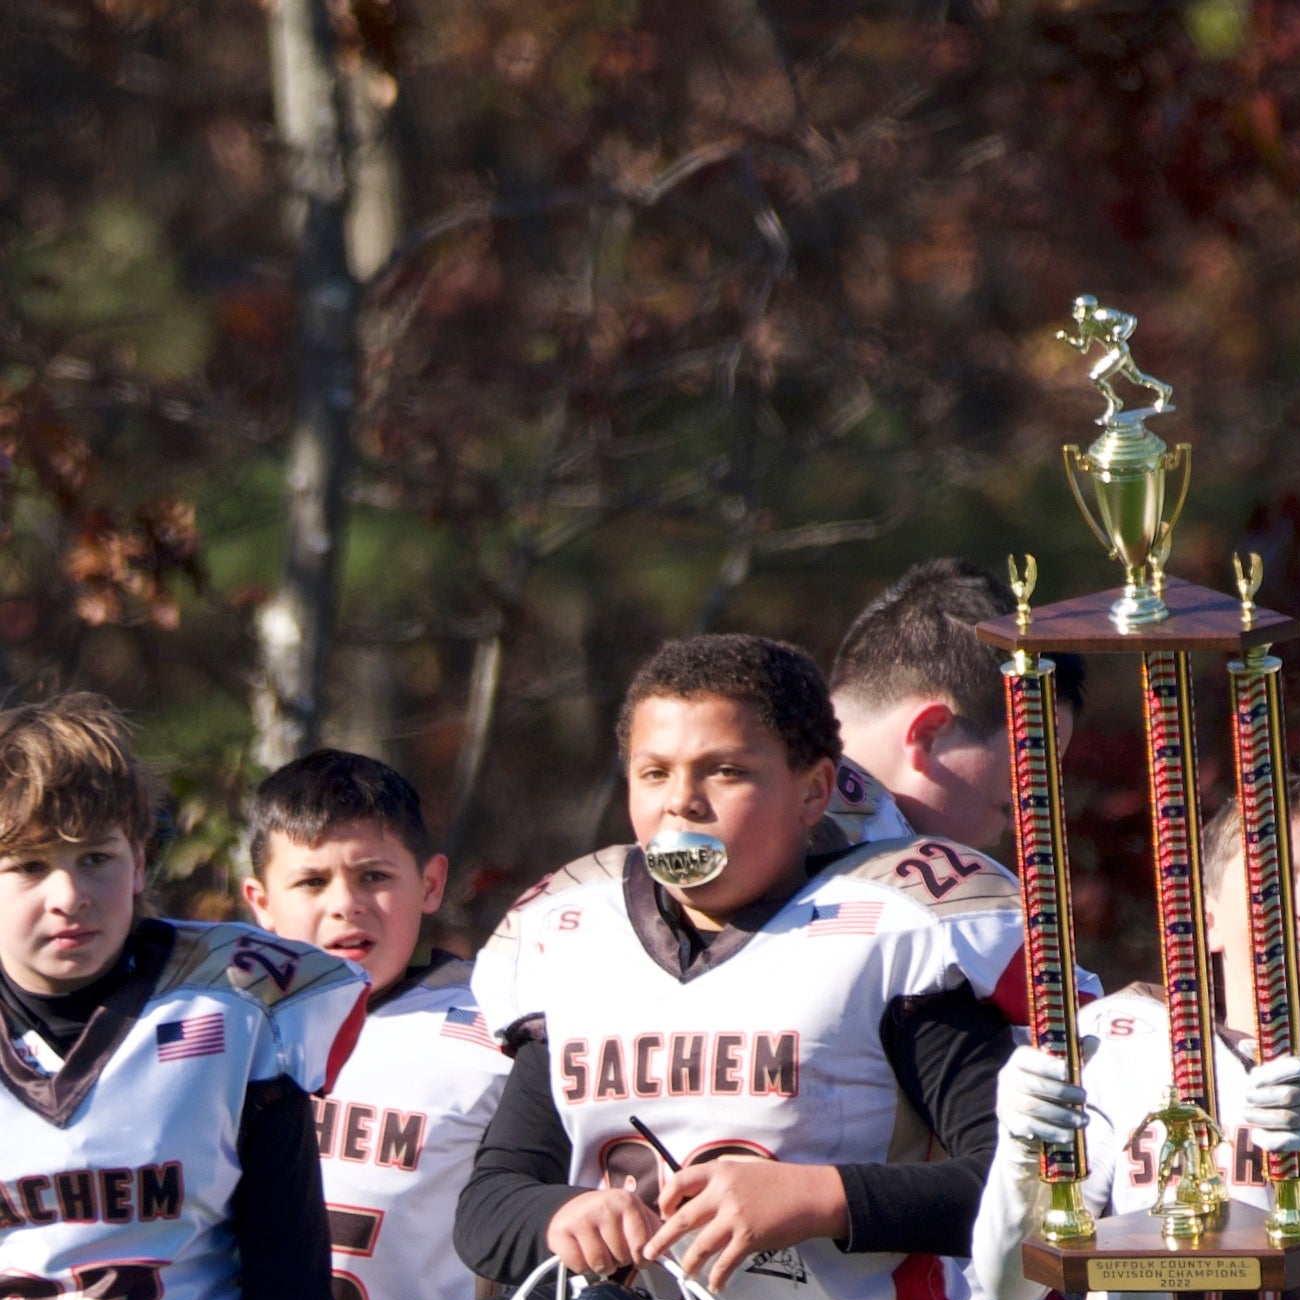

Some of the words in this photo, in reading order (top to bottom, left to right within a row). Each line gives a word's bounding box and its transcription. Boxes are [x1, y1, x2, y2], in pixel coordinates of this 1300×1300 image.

[895, 841, 984, 902] 22
[560, 1031, 800, 1105] SACHEM
[311, 1097, 427, 1172] HEM
[0, 1160, 185, 1230] ACHEM
[1096, 1261, 1155, 1270] SUFFOLK
[1160, 1260, 1211, 1269] COUNTY
[1103, 1270, 1163, 1279] DIVISION
[1168, 1269, 1247, 1279] CHAMPIONS
[1160, 1280, 1191, 1288] 2022
